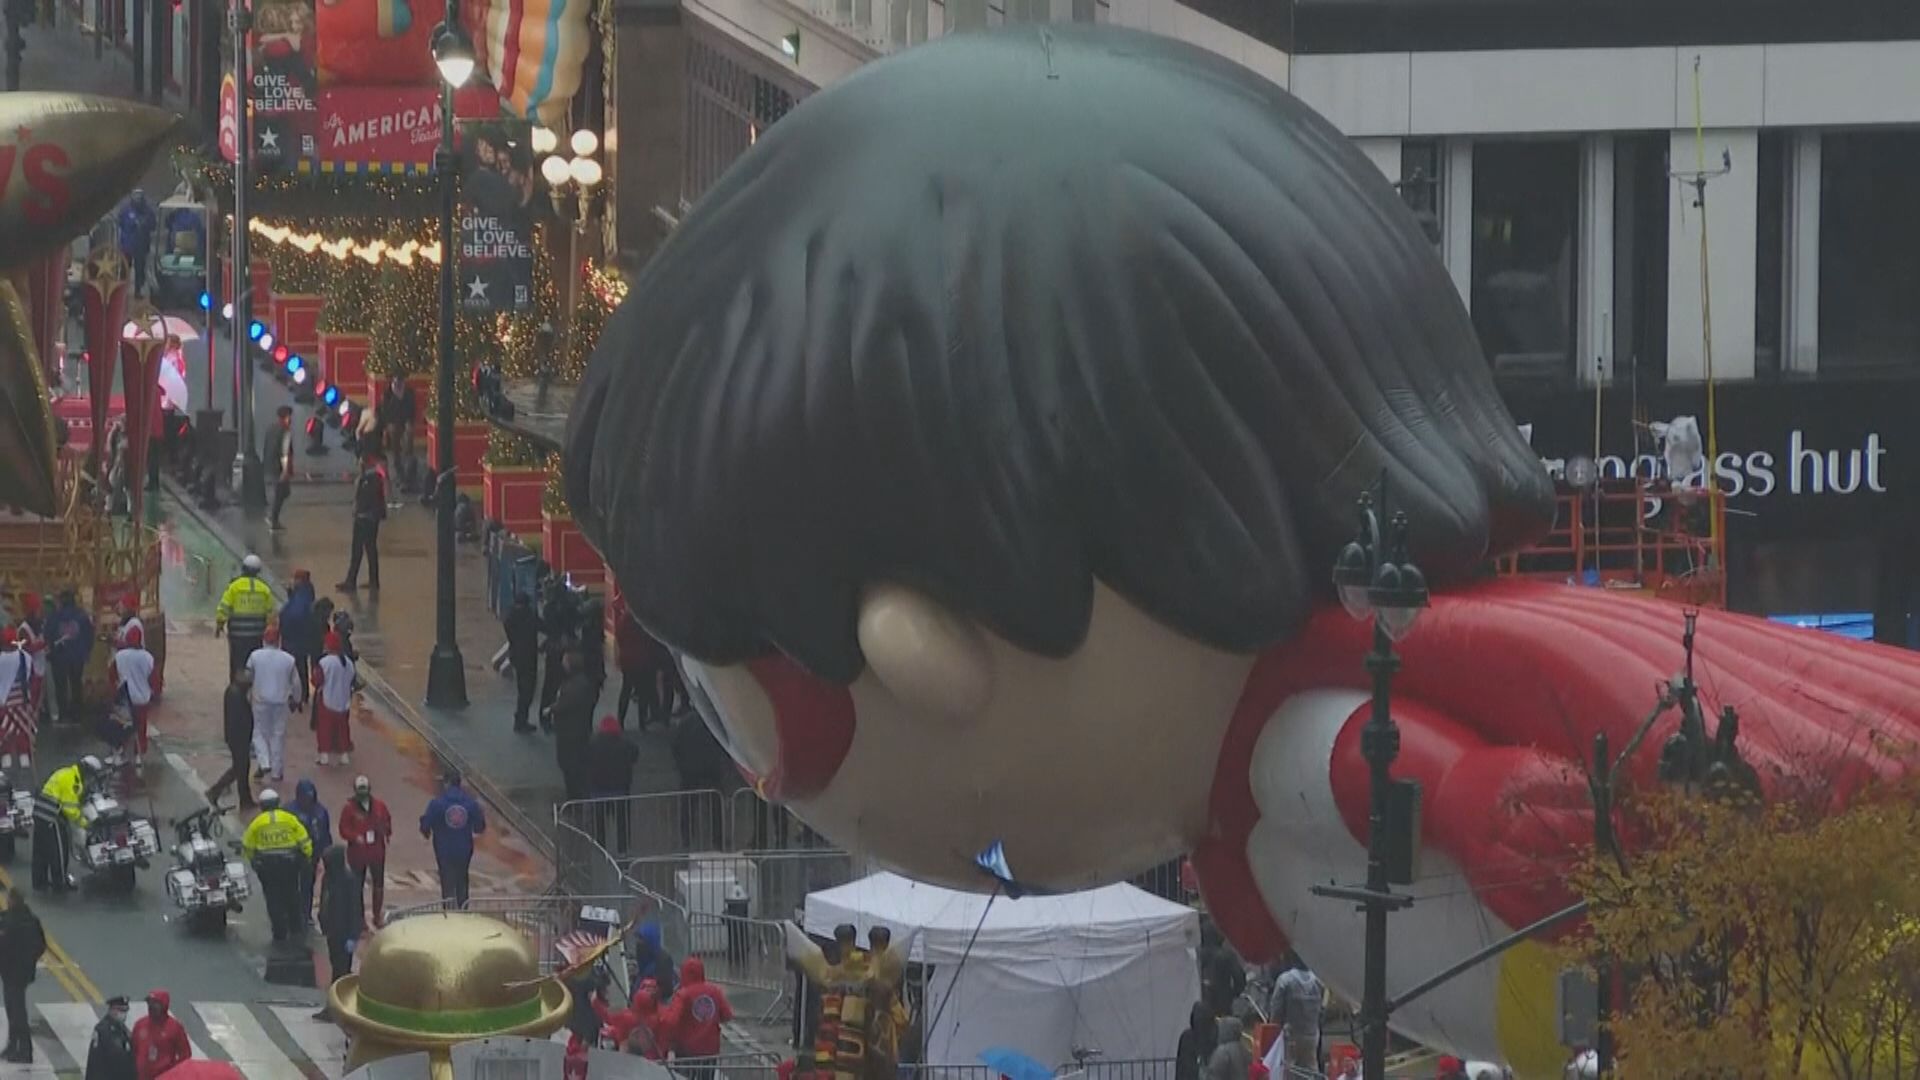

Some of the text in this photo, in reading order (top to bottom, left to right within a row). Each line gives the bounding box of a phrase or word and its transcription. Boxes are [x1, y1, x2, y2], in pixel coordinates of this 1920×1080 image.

[254, 74, 290, 87] GIVE.
[264, 87, 305, 98] LOVE.
[255, 98, 318, 110] BELIEVE.
[462, 216, 503, 230] GIVE.
[474, 231, 519, 244] LOVE.
[463, 244, 532, 258] BELIEVE.
[1791, 430, 1887, 494] hut
